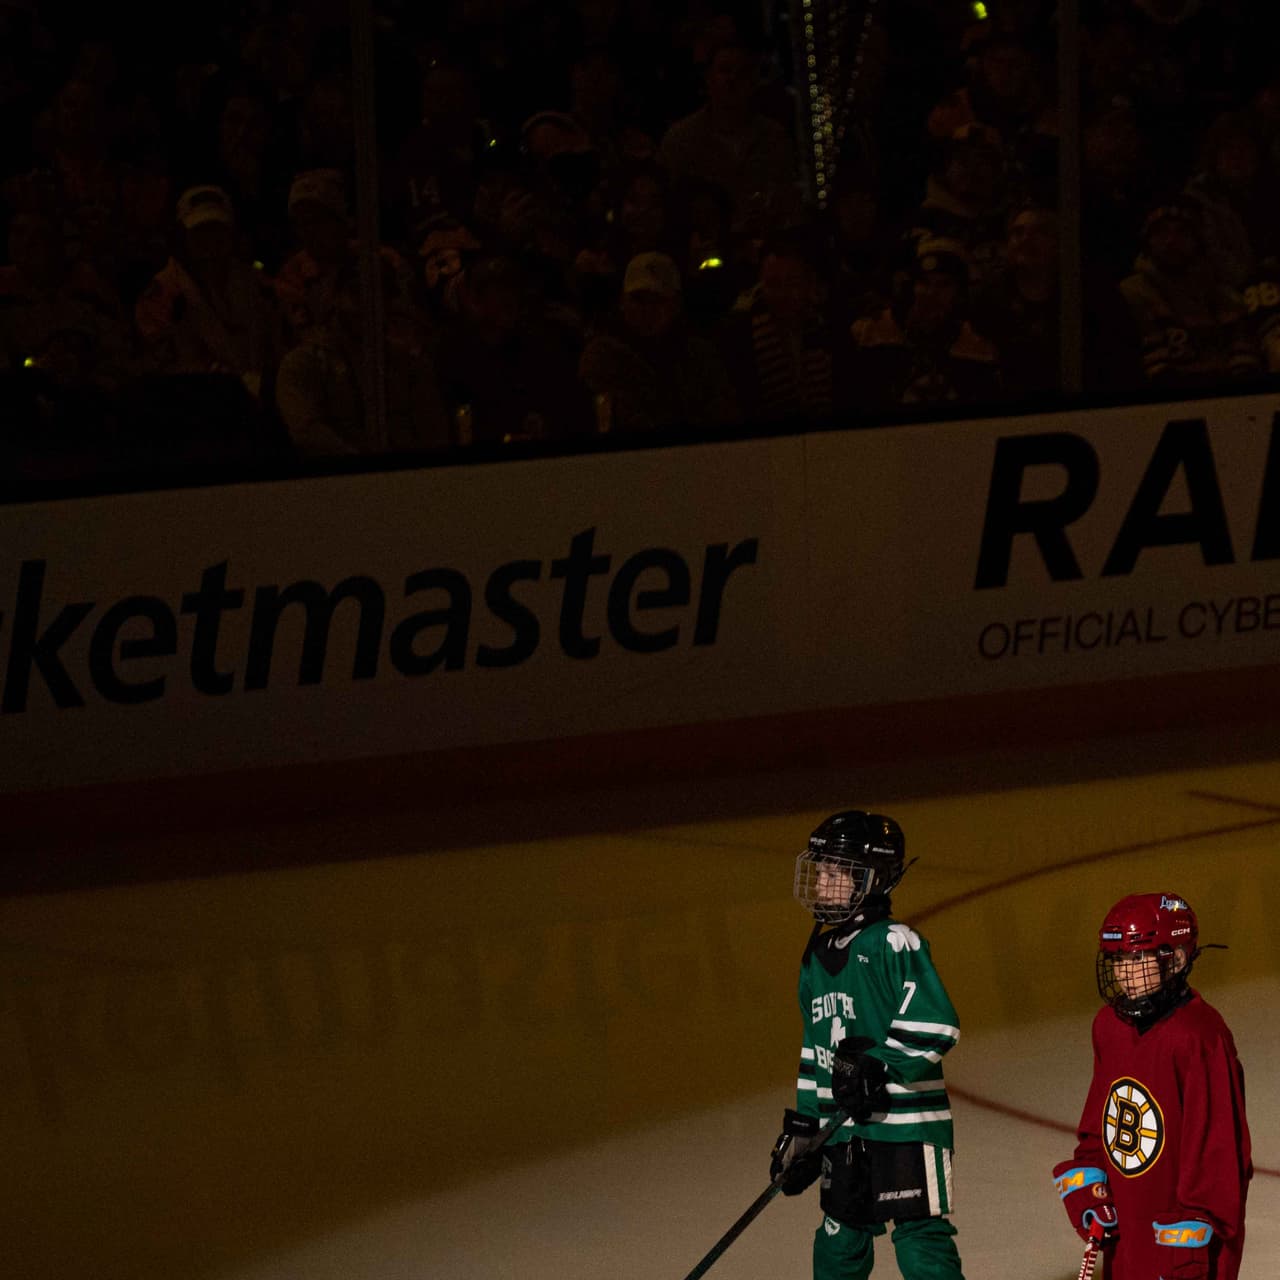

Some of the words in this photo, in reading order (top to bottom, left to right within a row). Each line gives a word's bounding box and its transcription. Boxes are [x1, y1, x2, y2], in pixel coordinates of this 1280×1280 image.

[979, 606, 1167, 661] OFFICIAL
[898, 980, 917, 1015] 7
[1115, 1098, 1143, 1156] B
[1155, 1227, 1208, 1246] CM
